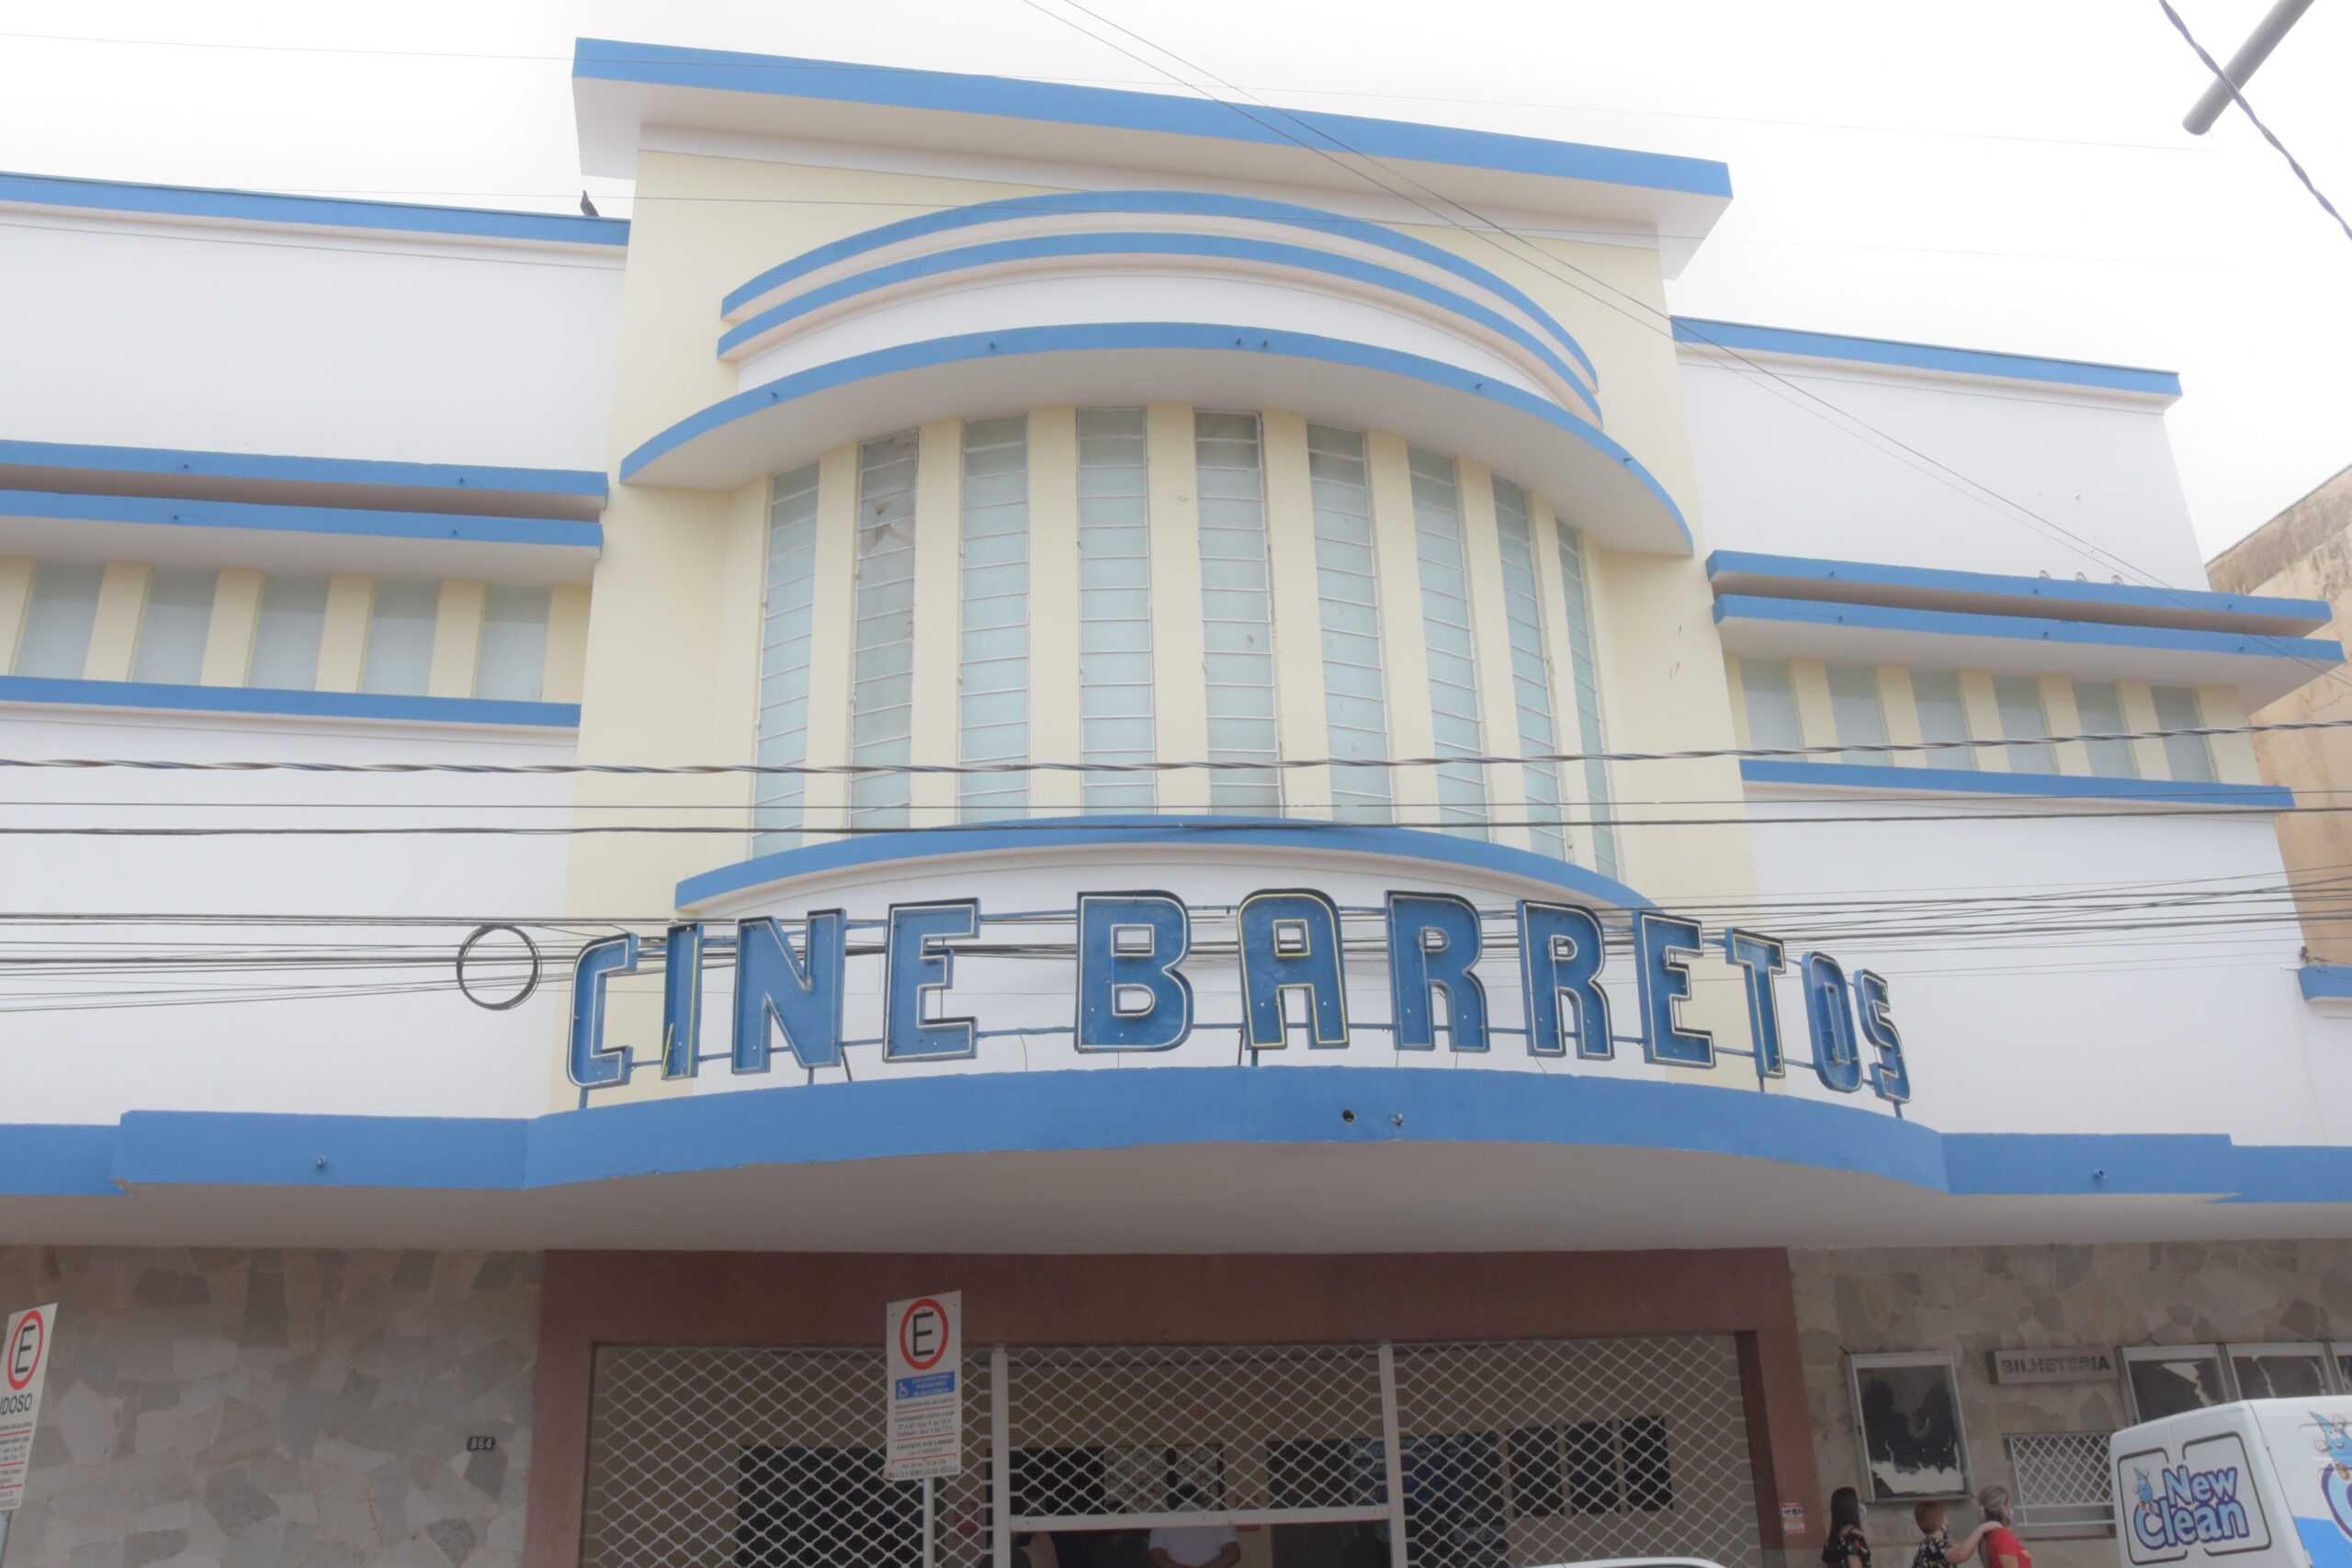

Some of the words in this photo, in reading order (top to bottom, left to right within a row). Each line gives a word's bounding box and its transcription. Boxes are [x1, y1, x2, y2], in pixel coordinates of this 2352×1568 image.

[566, 897, 981, 1089] CINE
[1074, 888, 1911, 1103] BARRETOS
[15, 1325, 36, 1374] E
[912, 1311, 934, 1357] E
[2000, 1355, 2111, 1374] BILHETERIA
[471, 1438, 492, 1449] 864
[2162, 1465, 2237, 1508] New
[2133, 1496, 2250, 1550] Clean
